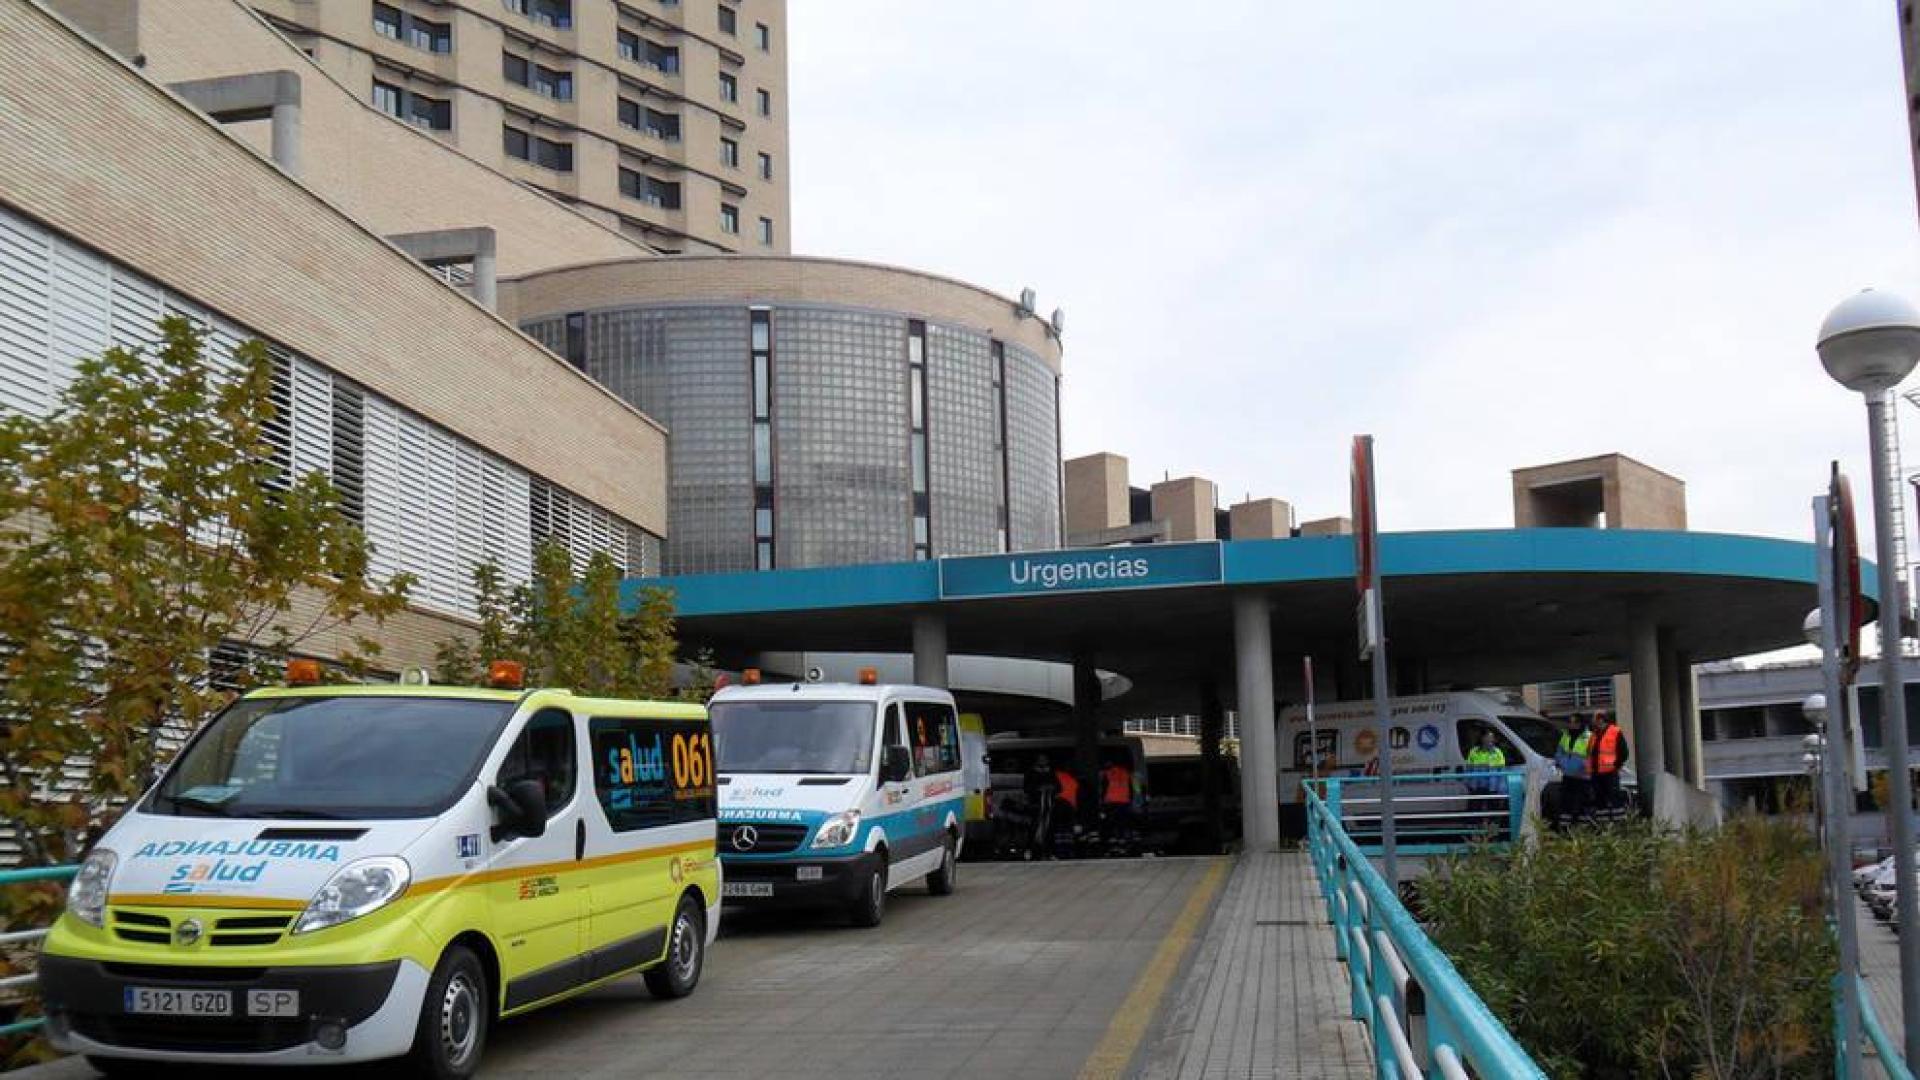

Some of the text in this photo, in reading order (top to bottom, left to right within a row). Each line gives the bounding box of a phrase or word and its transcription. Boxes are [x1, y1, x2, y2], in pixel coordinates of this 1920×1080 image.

[1010, 554, 1149, 588] Urgencias
[609, 733, 712, 788] salud 061
[170, 858, 268, 882] salud
[140, 992, 228, 1013] 5121 GZD
[256, 992, 292, 1013] SP
